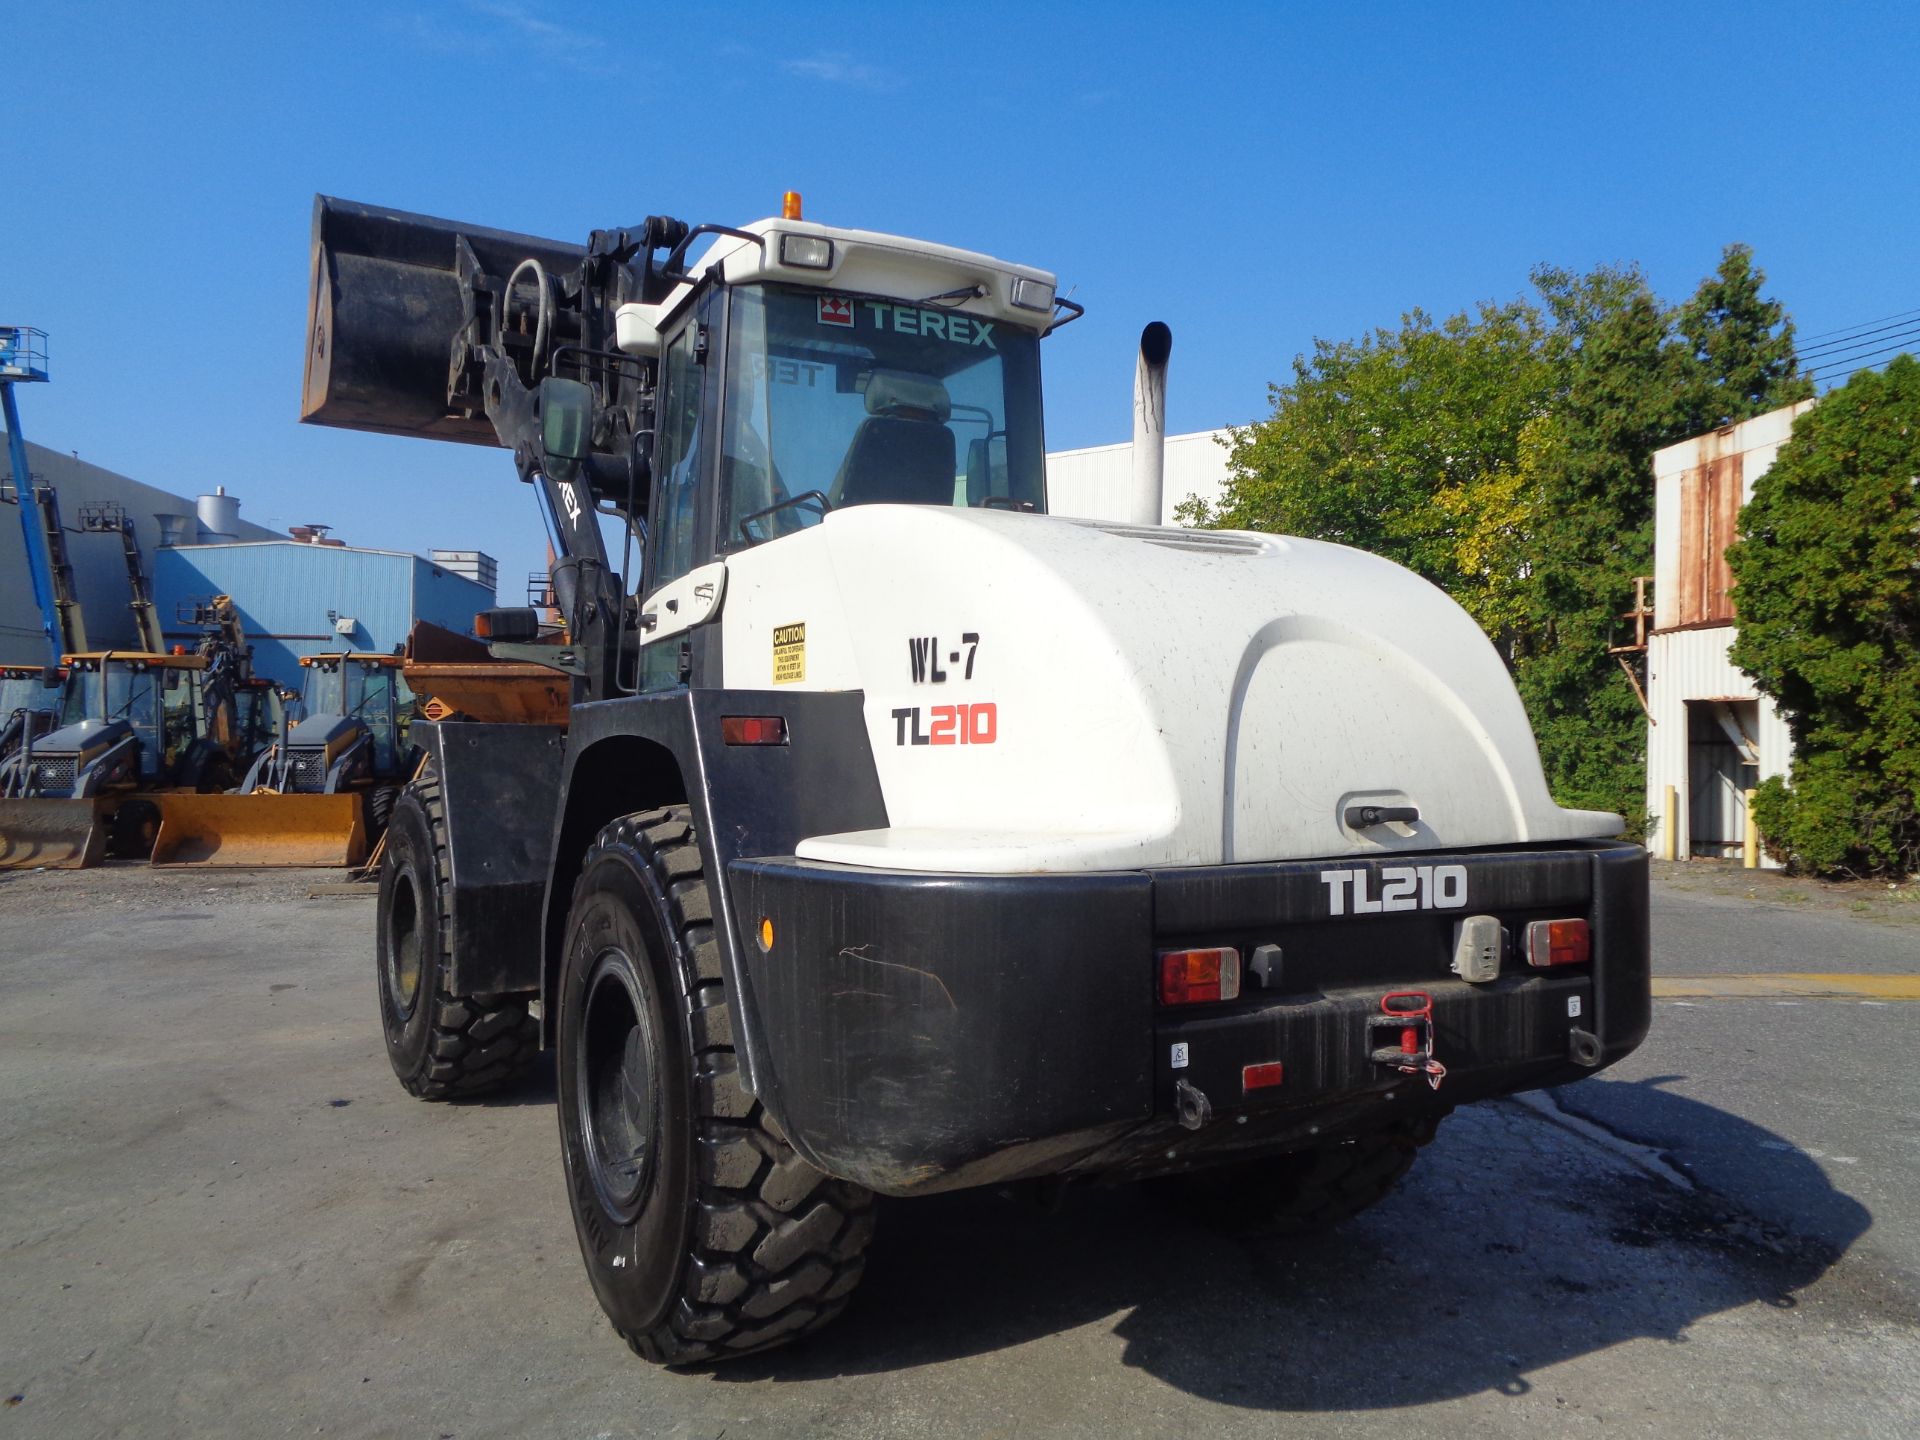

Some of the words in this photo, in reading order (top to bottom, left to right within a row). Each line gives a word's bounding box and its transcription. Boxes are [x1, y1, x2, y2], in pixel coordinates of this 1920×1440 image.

[864, 301, 997, 350] TEREX
[774, 626, 805, 645] CAUTION
[892, 703, 997, 746] TL210
[1321, 865, 1468, 916] TL210
